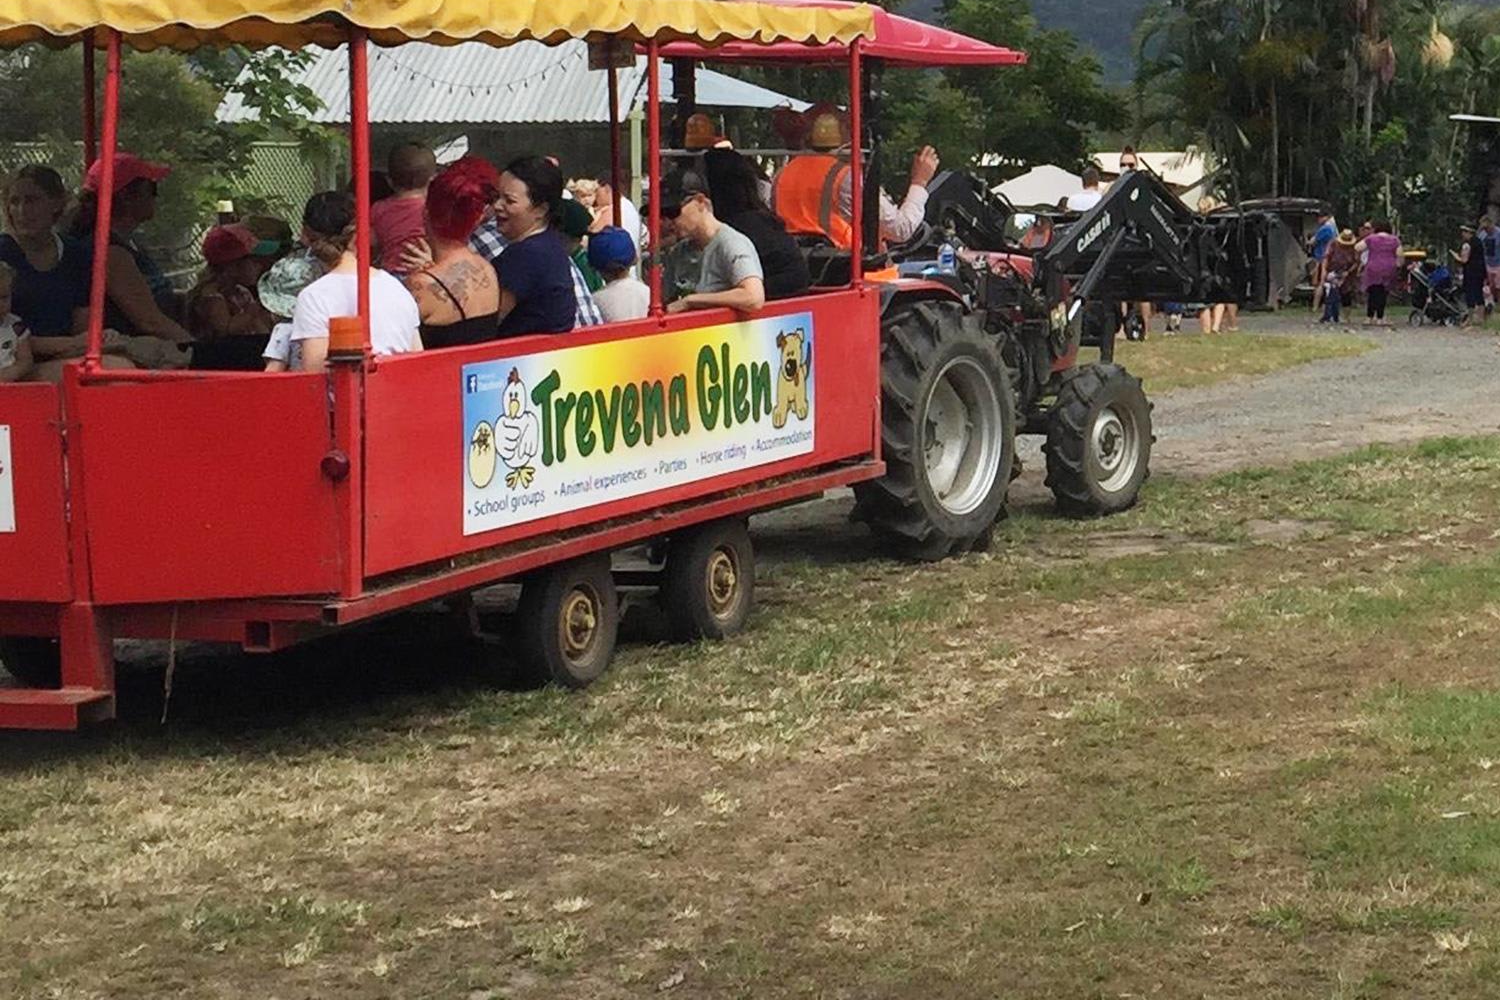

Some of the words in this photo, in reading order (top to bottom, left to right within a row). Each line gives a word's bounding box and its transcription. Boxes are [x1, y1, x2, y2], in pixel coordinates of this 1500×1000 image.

[531, 369, 690, 467] Trevena
[696, 341, 772, 430] Glen
[474, 495, 509, 517] School
[511, 490, 545, 512] groups
[560, 476, 593, 497] Animal
[594, 468, 647, 491] experiences
[659, 458, 688, 476] Parties
[700, 449, 723, 466] Horse
[724, 444, 748, 461] riding
[756, 429, 813, 451] Accommodation
